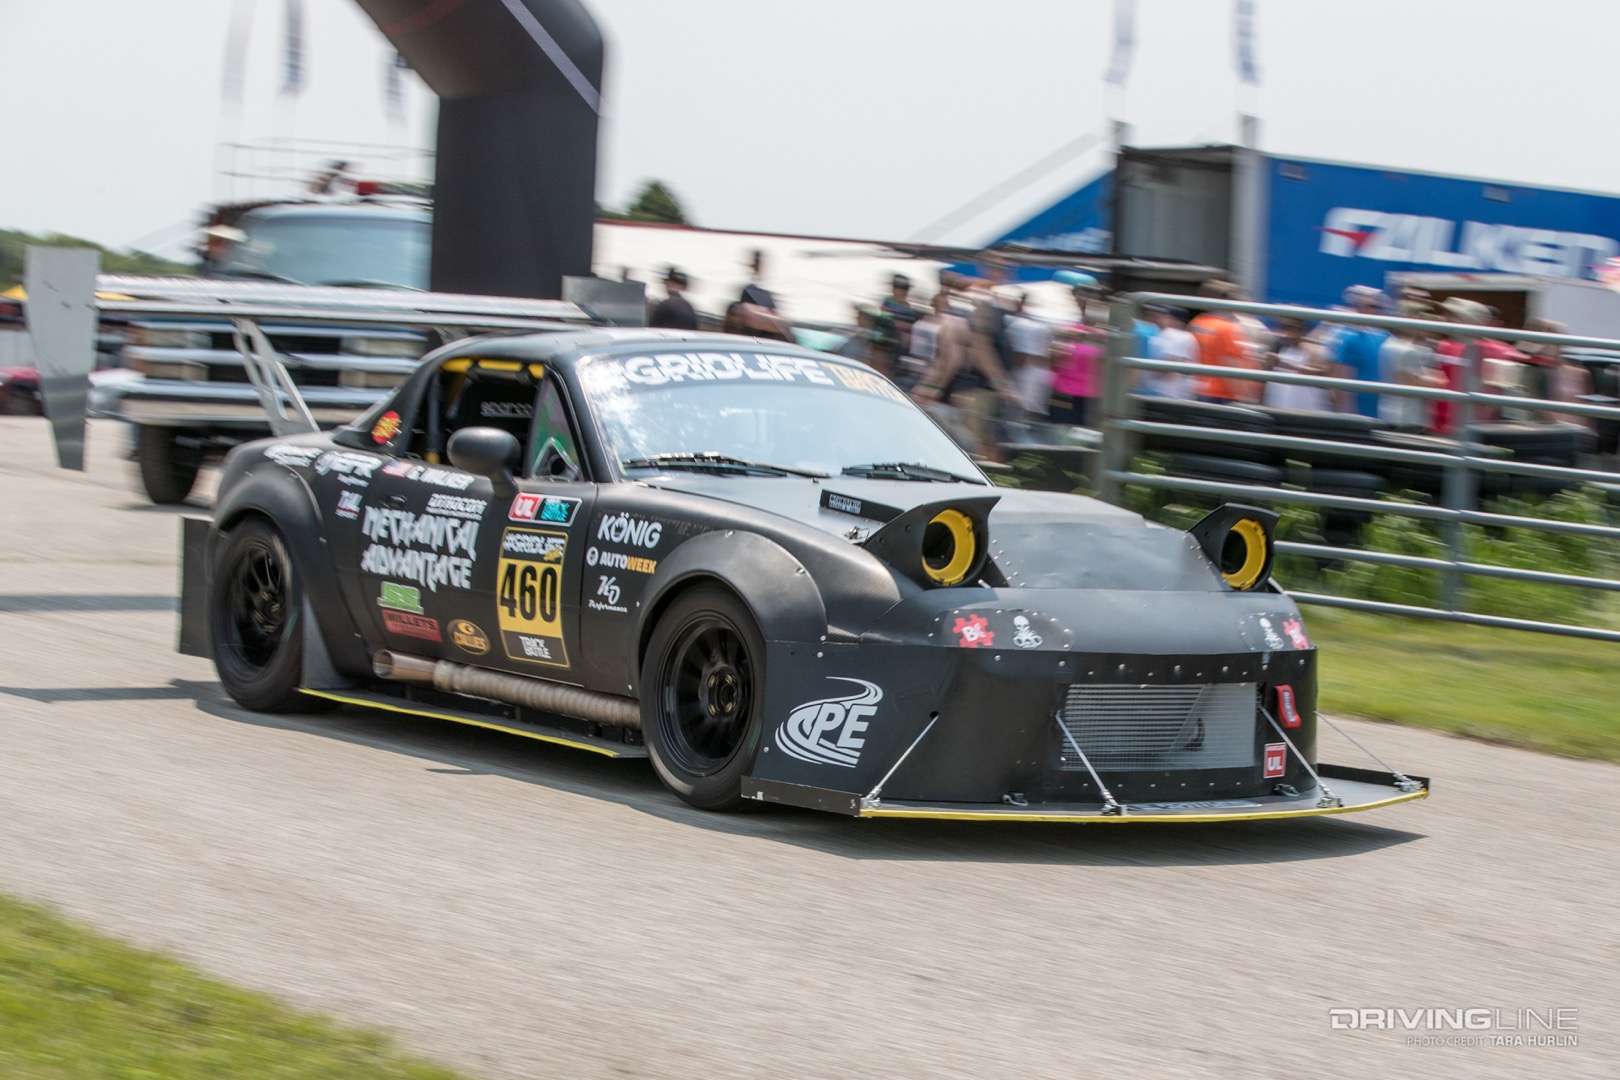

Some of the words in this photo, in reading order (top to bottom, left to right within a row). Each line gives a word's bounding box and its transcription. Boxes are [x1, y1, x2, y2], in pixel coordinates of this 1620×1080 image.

[597, 511, 663, 549] KÖNIG
[360, 543, 473, 593] ADVANTAGE
[599, 551, 657, 574] AUTOWEEK
[499, 563, 557, 623] 460
